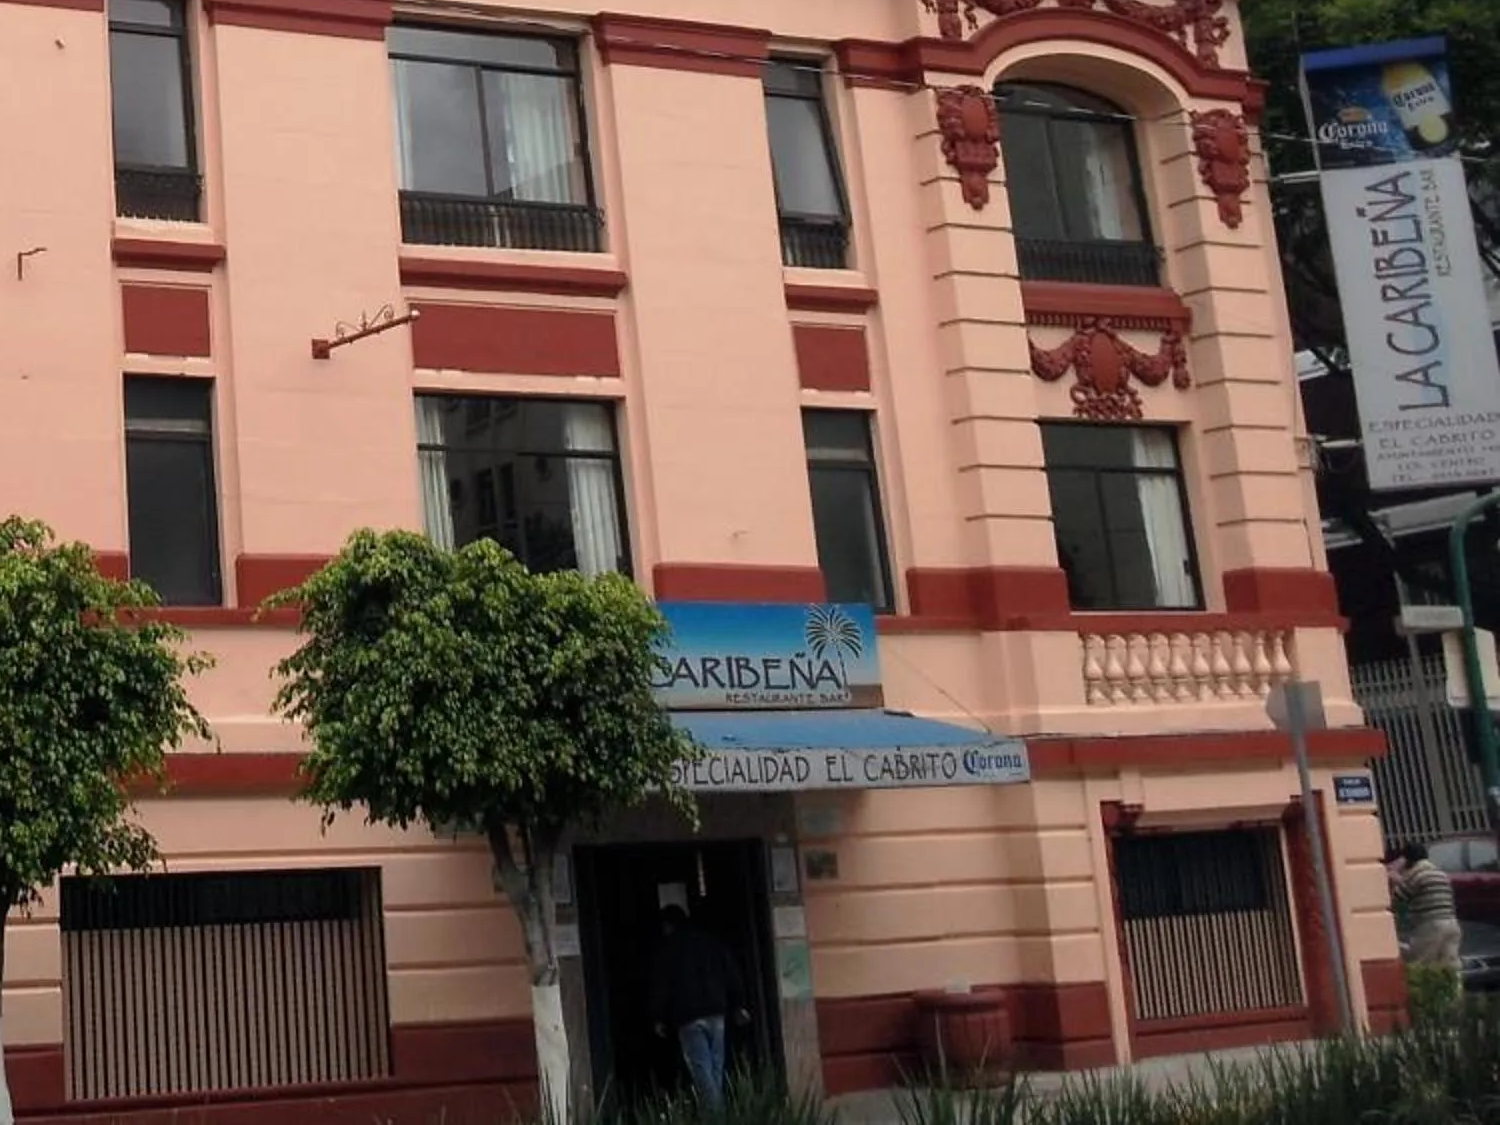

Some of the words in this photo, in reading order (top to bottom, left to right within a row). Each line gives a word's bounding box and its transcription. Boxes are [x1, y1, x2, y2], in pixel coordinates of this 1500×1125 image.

[1318, 121, 1389, 143] Corona
[1357, 170, 1440, 355] CARIBEÑA
[1395, 360, 1449, 411] LA
[725, 691, 815, 705] RESTAURANTE
[652, 754, 811, 786] SPECIALIDAD
[826, 754, 854, 783] EL
[863, 750, 957, 782] CABRITO
[962, 749, 1023, 774] Corona
